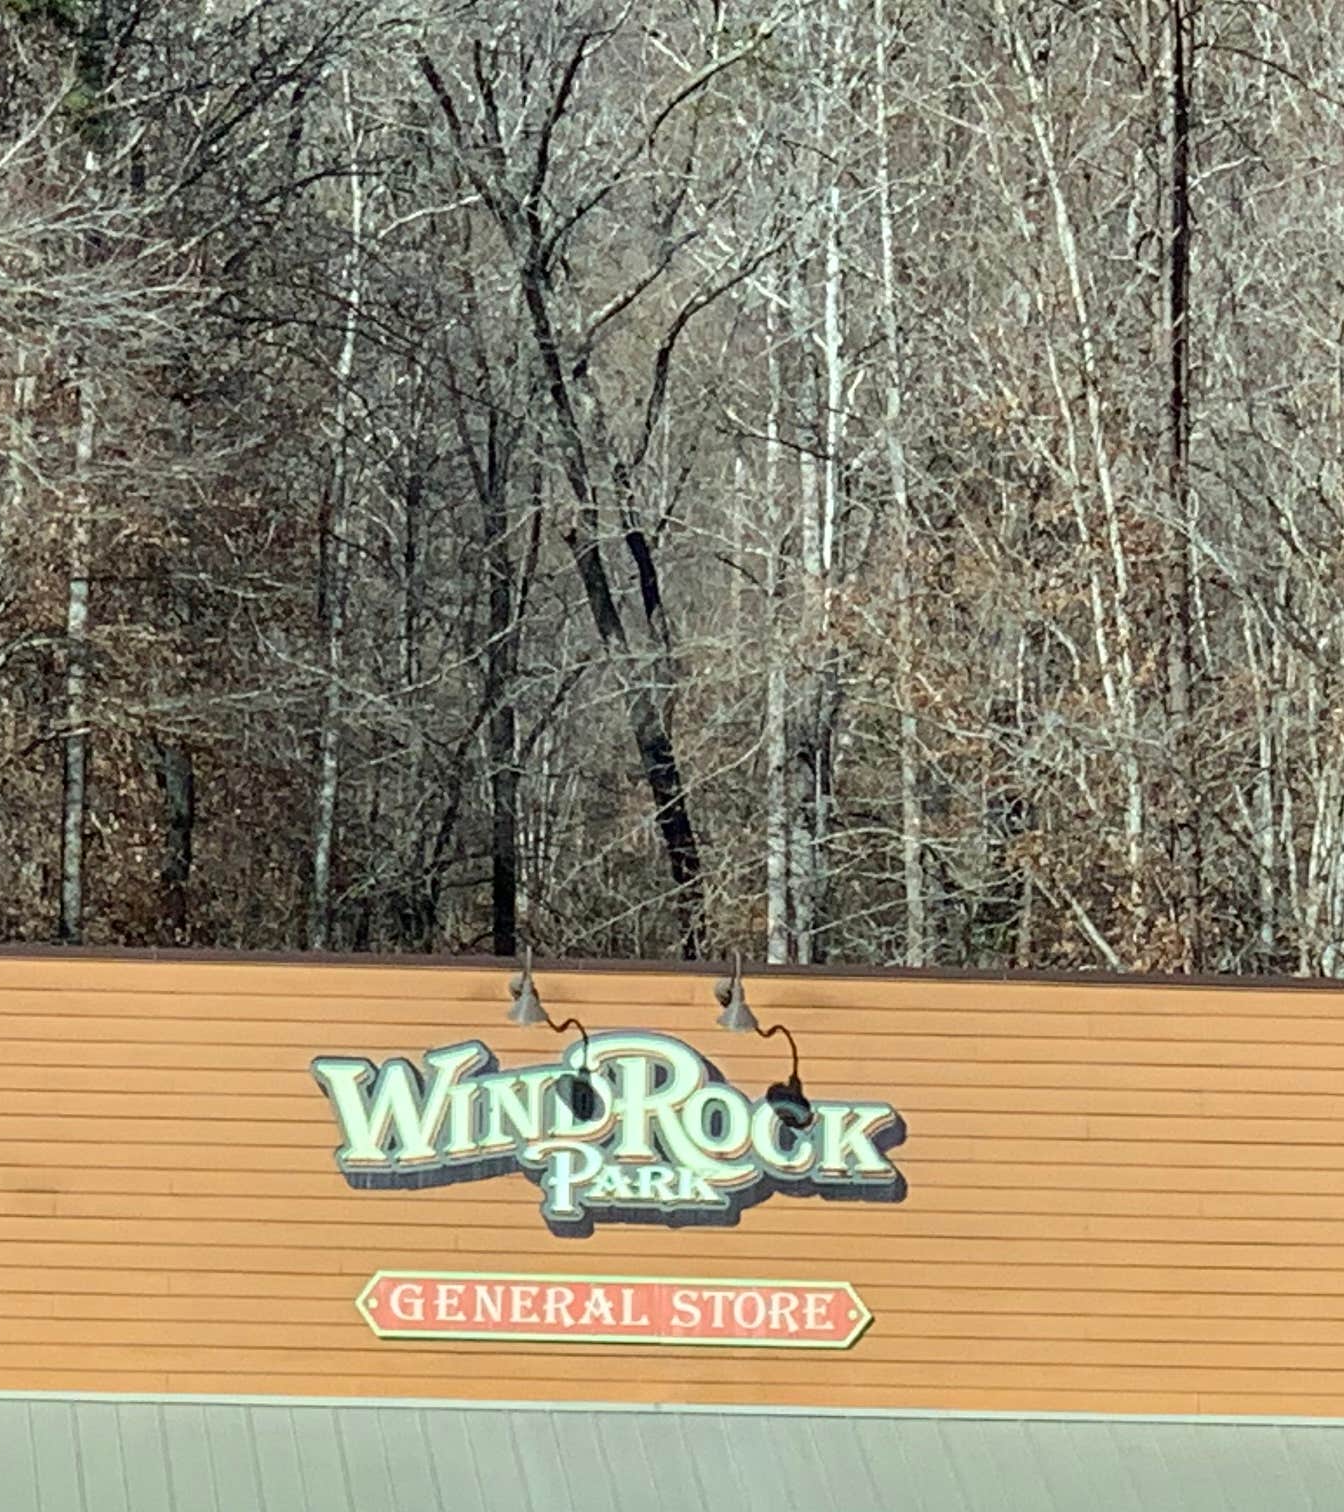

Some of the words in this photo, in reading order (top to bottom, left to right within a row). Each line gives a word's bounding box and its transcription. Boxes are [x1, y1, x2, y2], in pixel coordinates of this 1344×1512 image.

[312, 1032, 902, 1184] WINDROCK
[523, 1142, 726, 1214] PARK
[389, 1284, 650, 1326] GENERAL
[671, 1291, 836, 1334] STORE
